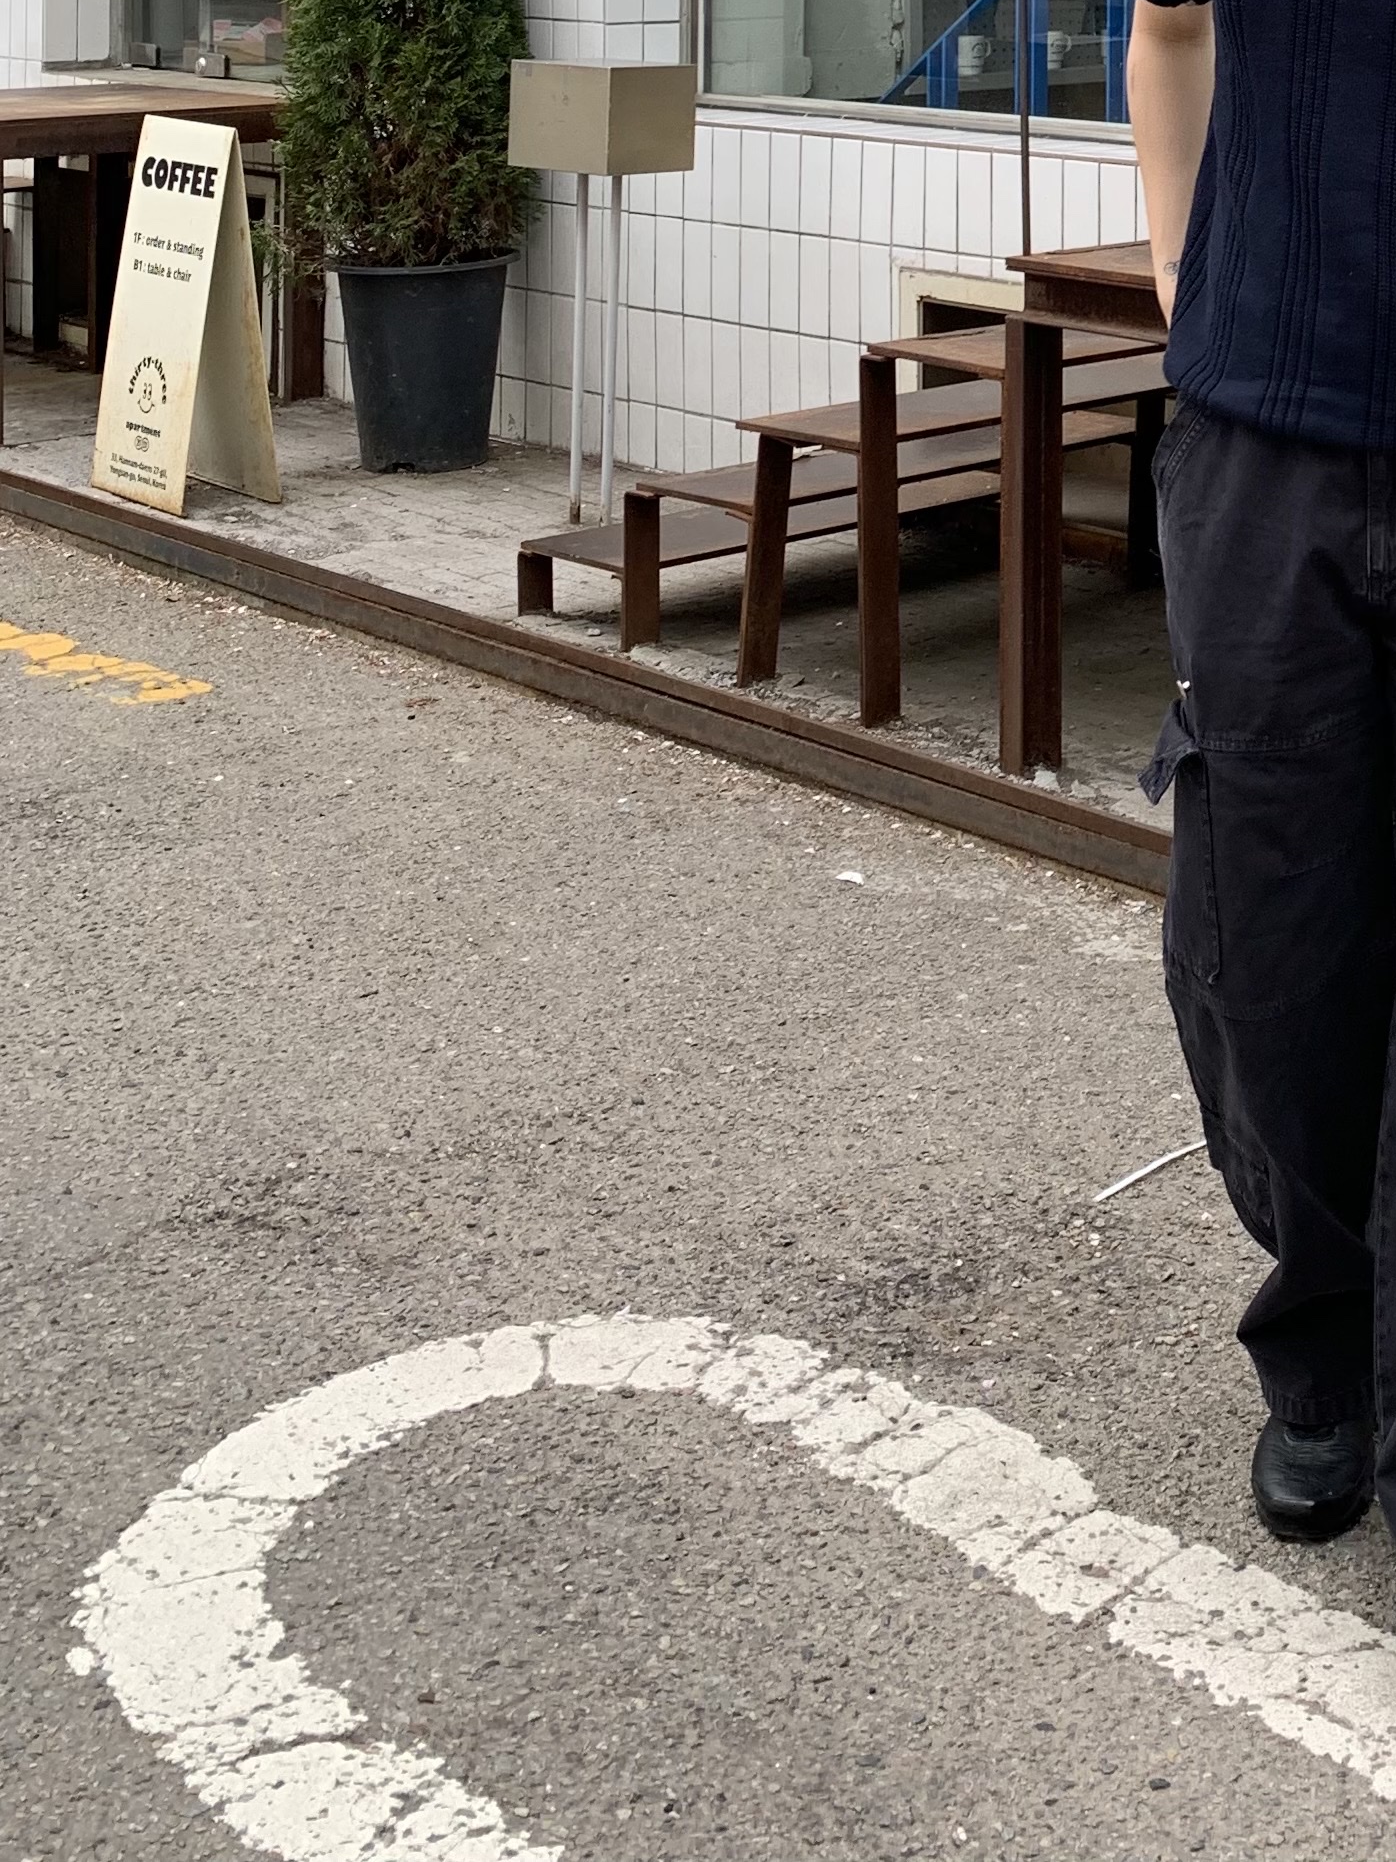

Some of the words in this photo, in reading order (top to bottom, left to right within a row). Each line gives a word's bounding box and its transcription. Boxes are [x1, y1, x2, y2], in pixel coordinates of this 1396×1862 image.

[141, 155, 219, 200] COFFEE
[146, 235, 166, 250] order
[166, 239, 172, 251] &
[173, 241, 205, 261] standing
[147, 262, 165, 278] table
[166, 266, 172, 279] &
[173, 267, 192, 283] chair
[126, 421, 160, 438] apartment
